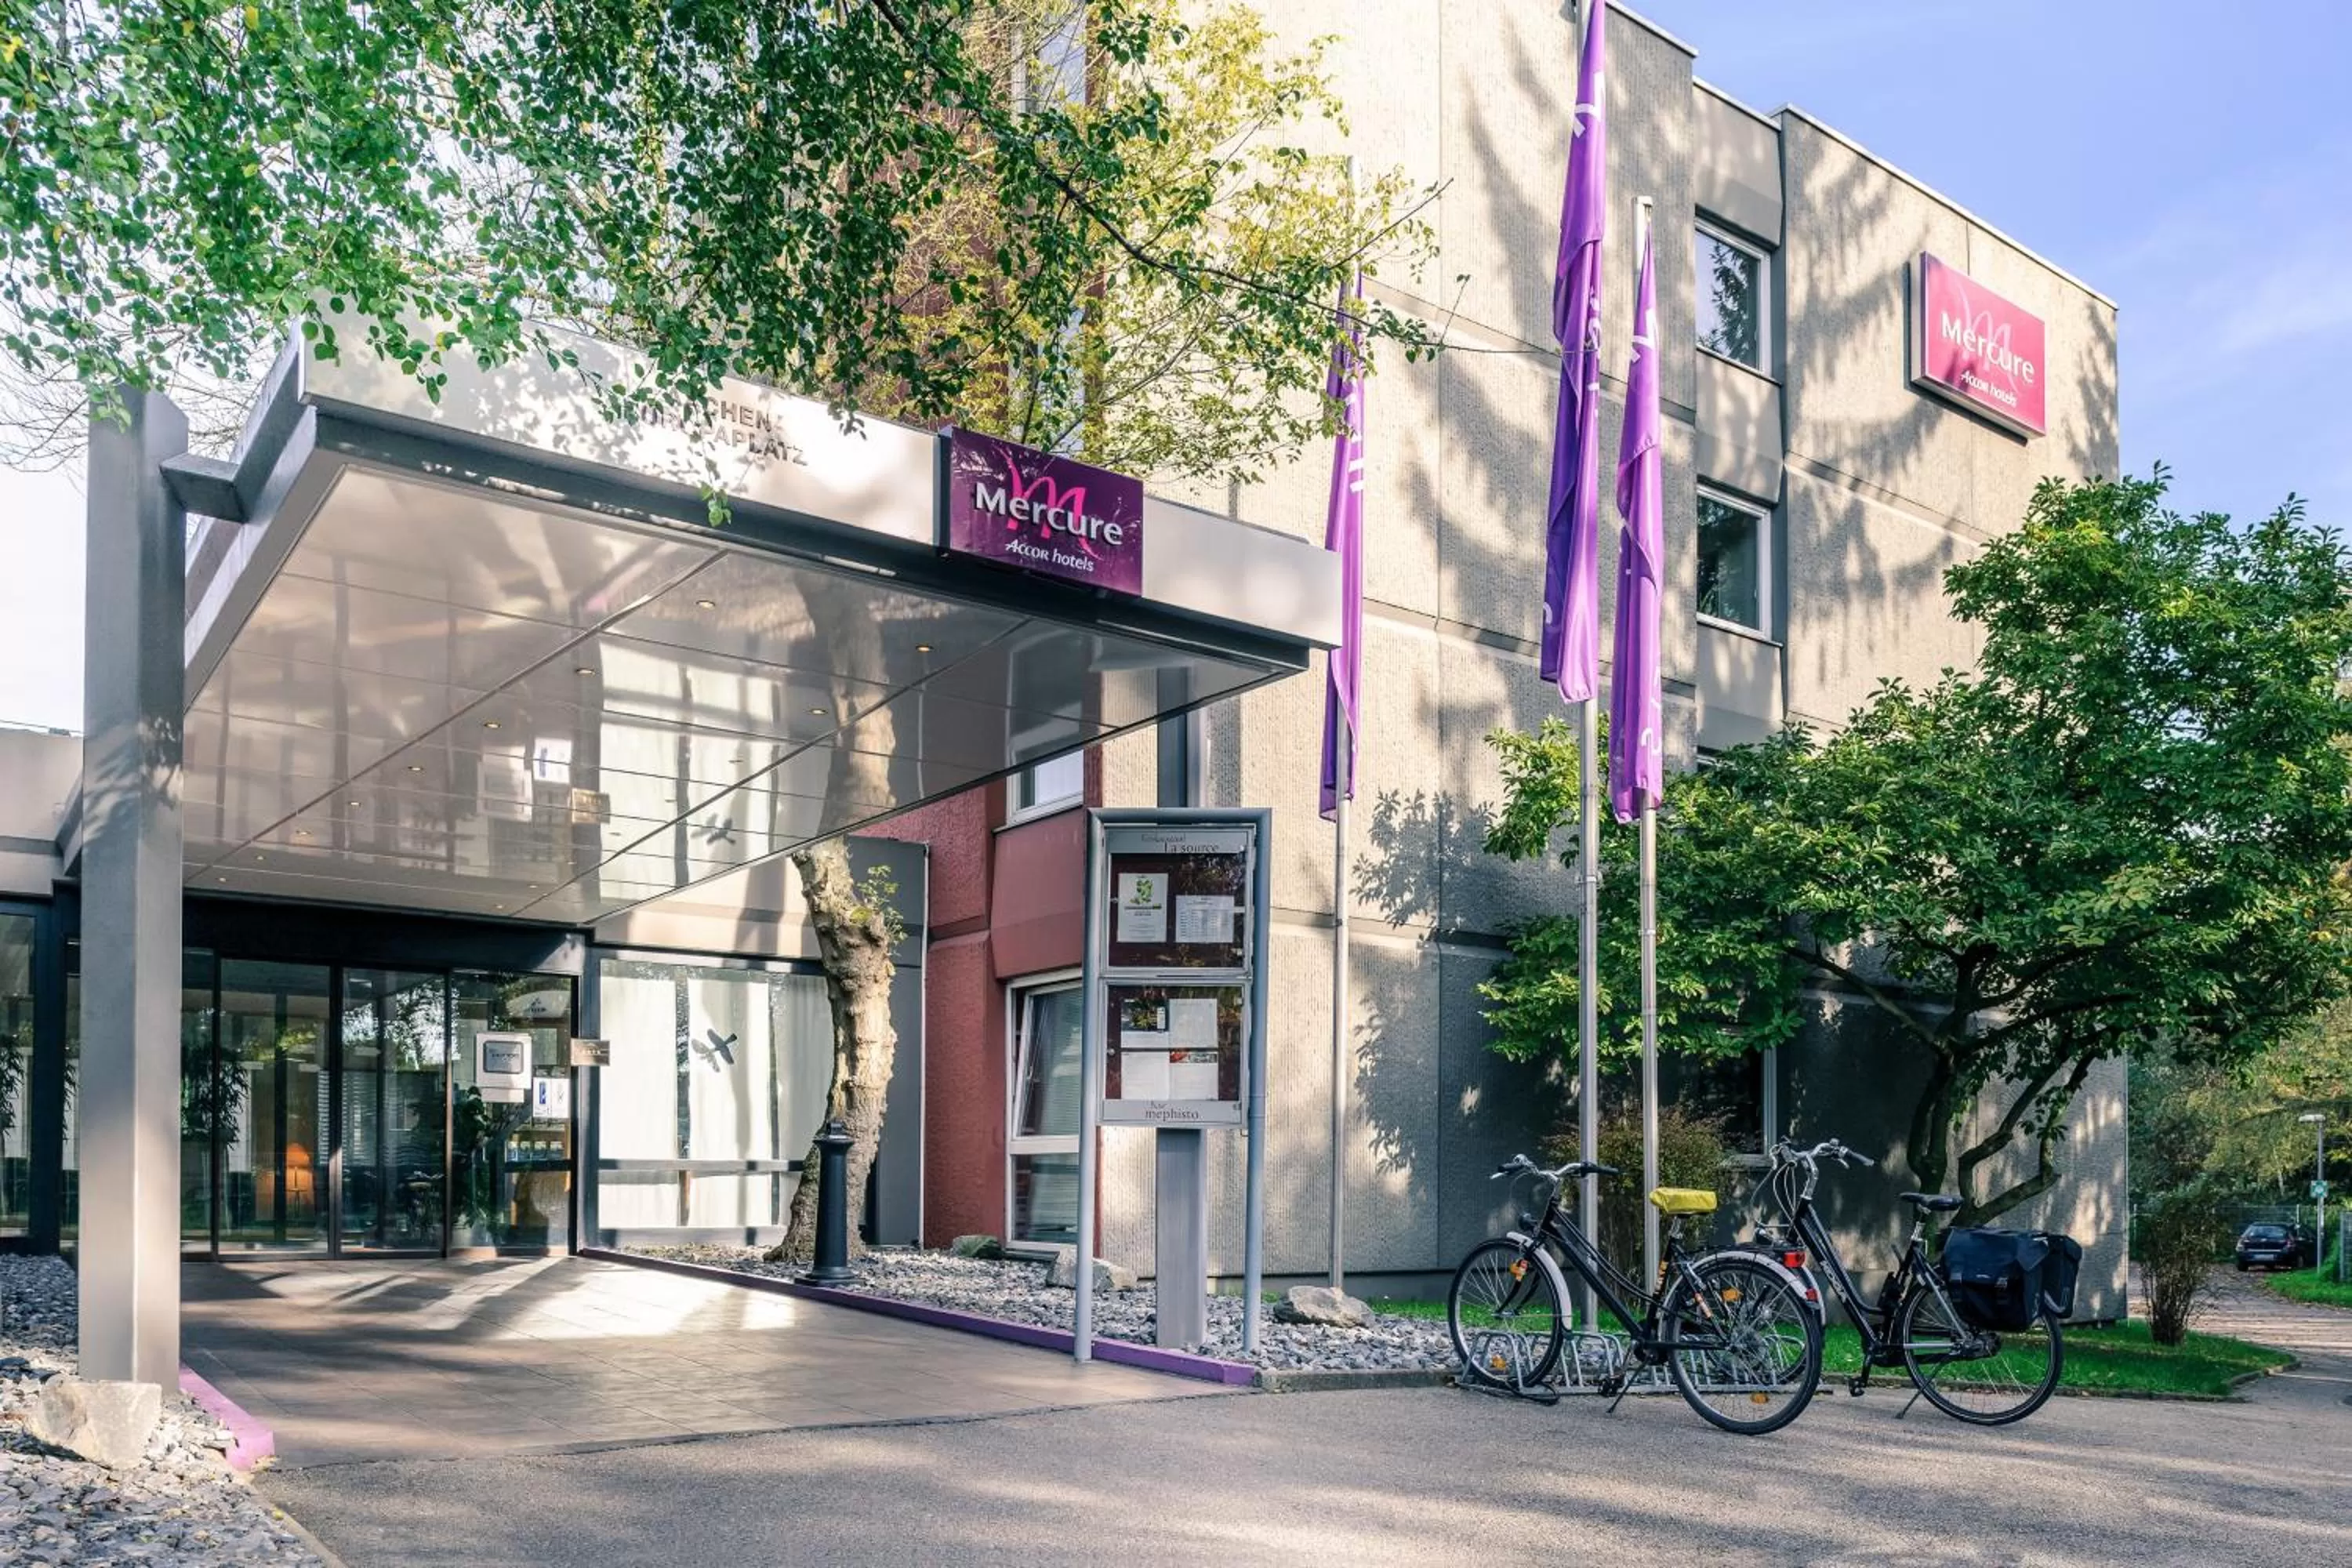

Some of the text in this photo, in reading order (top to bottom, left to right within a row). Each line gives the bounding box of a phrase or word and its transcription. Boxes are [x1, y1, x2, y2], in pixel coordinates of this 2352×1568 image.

[1940, 309, 2034, 384] Mercure
[975, 482, 1123, 546] Mercure
[1052, 548, 1094, 572] hotels
[1145, 1108, 1199, 1122] mephisto
